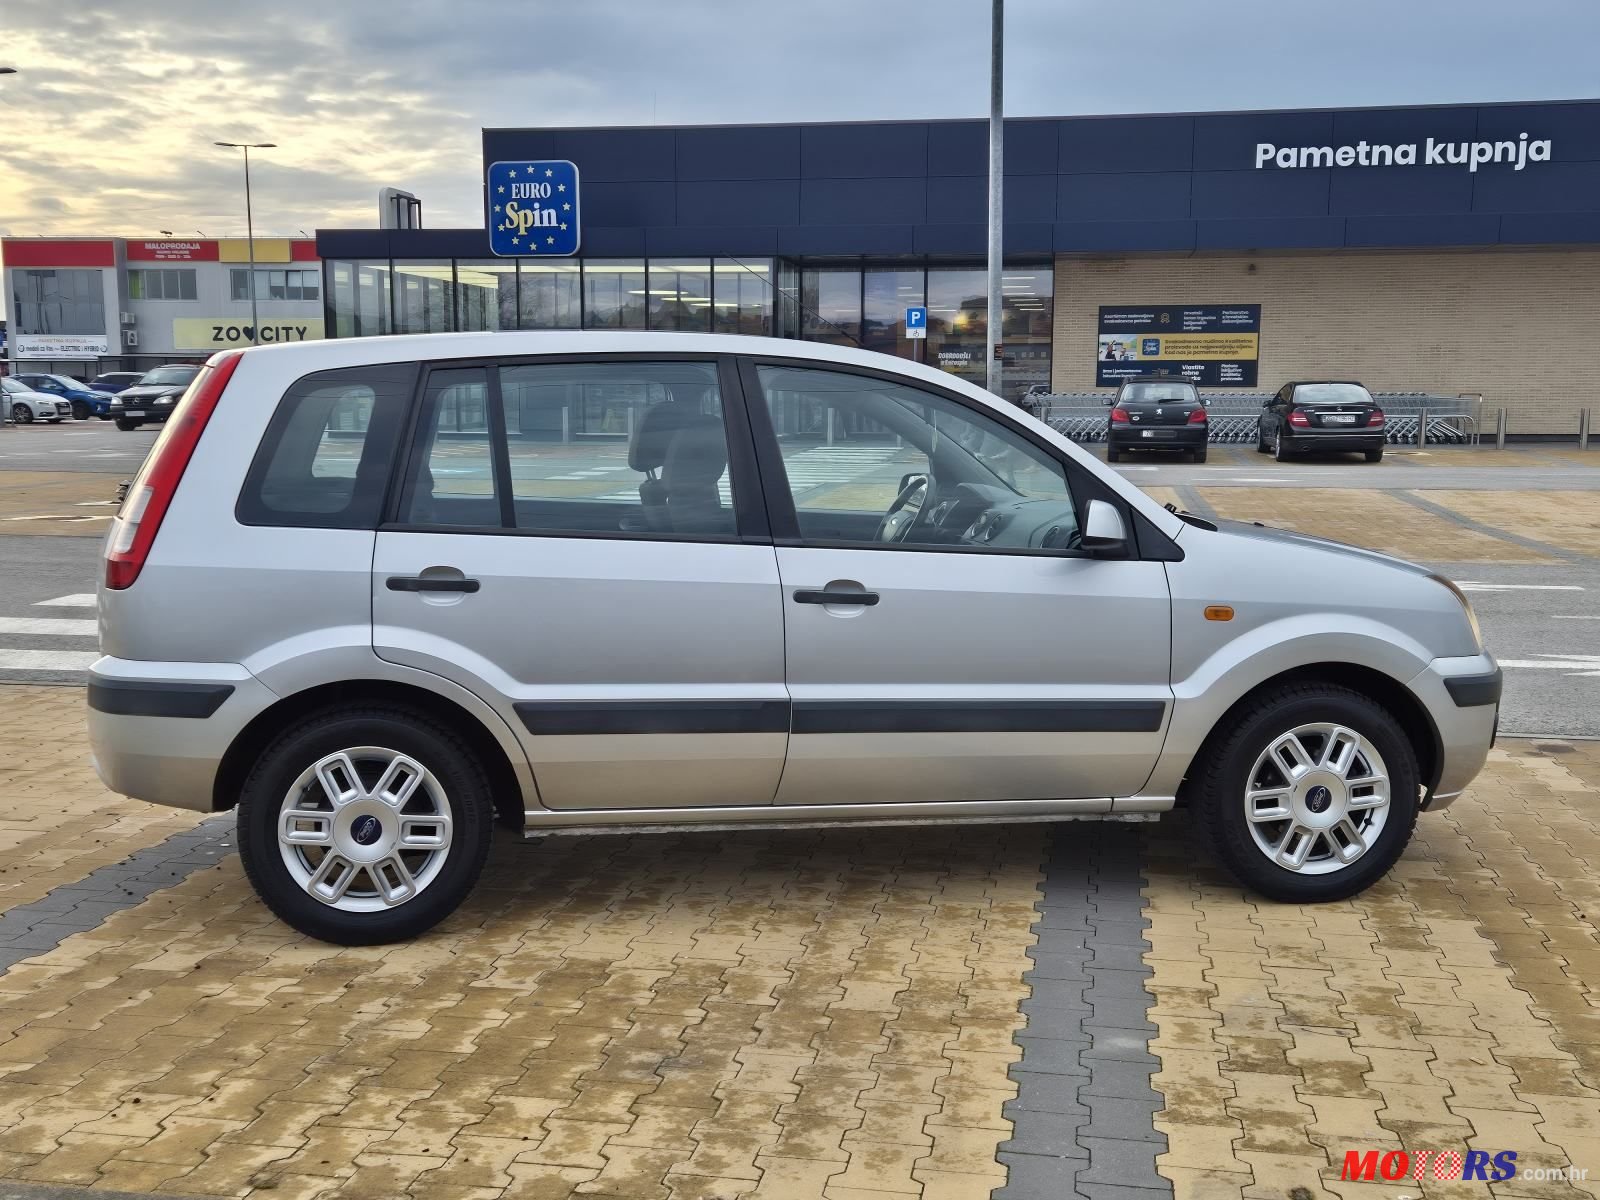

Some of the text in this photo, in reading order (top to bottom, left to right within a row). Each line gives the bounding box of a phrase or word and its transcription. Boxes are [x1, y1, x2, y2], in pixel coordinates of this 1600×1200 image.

[1256, 132, 1552, 173] Pametna kupnja
[511, 182, 552, 199] EURO
[505, 201, 559, 235] Spin
[144, 242, 201, 250] MALOPRODAJA
[911, 311, 921, 324] P
